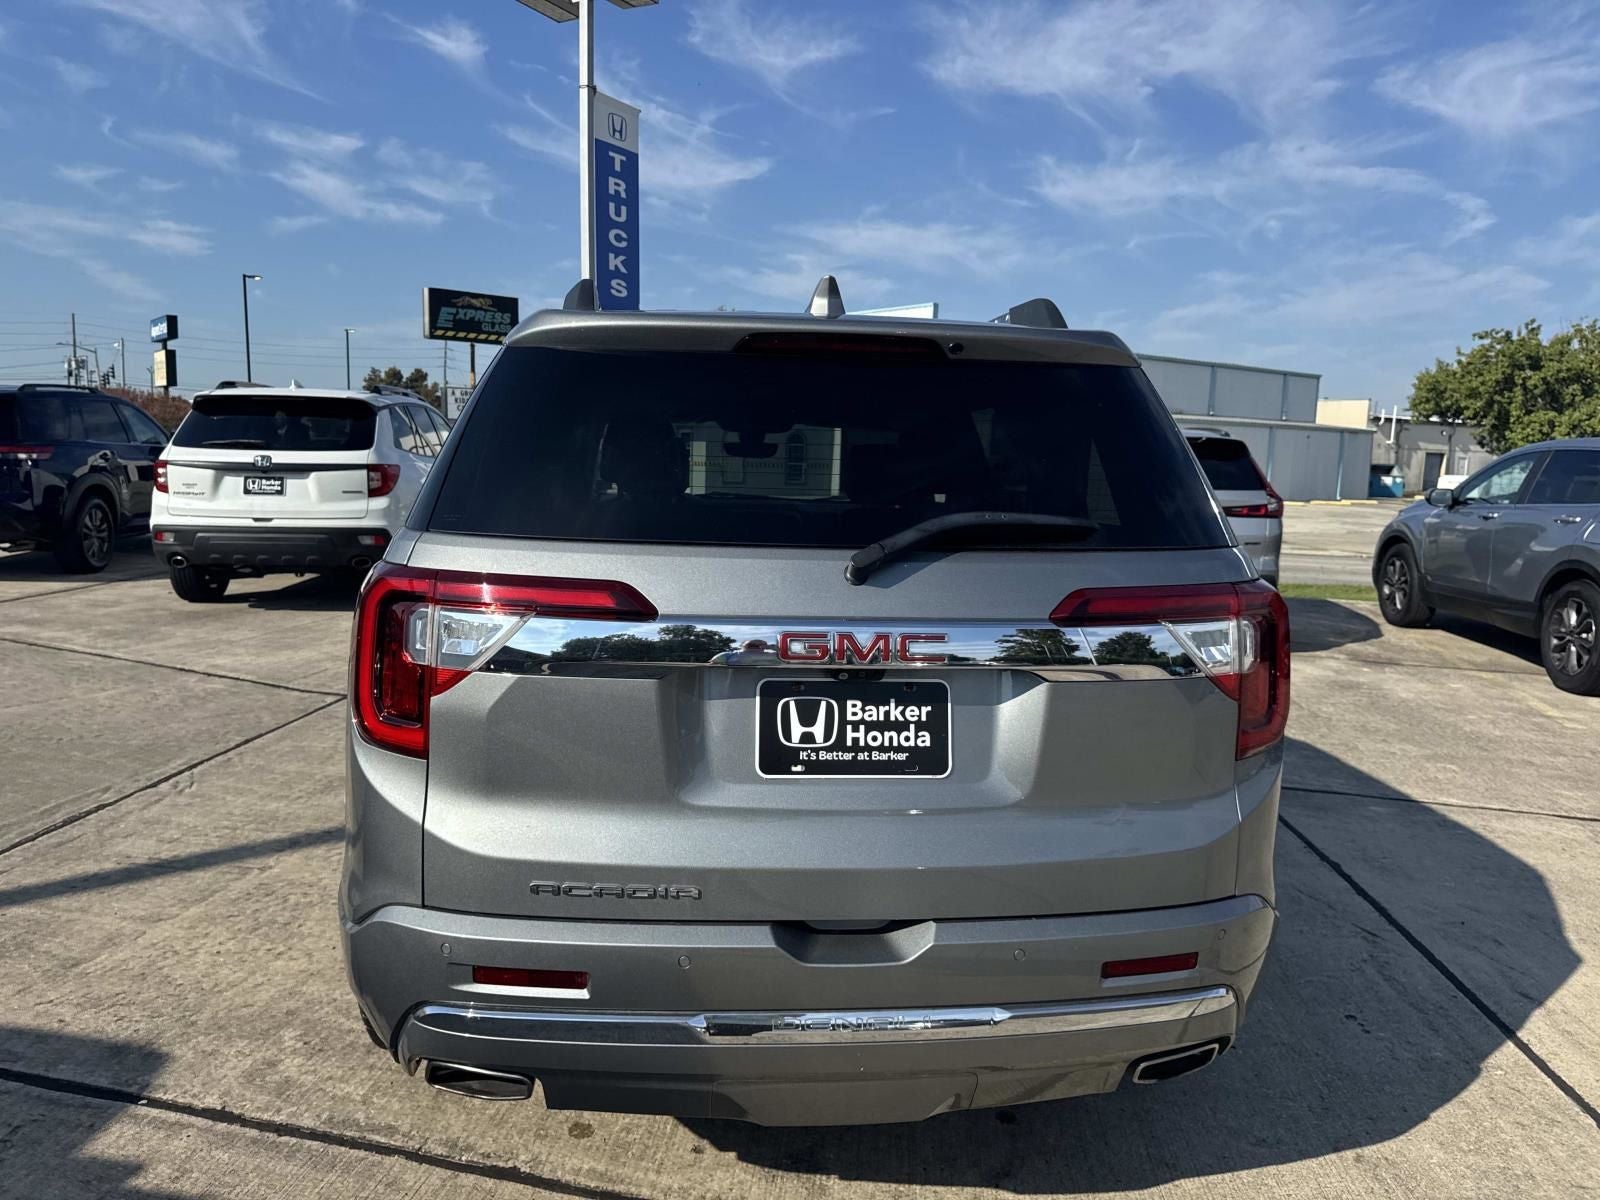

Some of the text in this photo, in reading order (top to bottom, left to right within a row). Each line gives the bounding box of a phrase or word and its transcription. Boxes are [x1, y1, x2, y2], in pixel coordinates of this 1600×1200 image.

[608, 151, 629, 298] TRUCKS
[436, 306, 512, 328] EXPRESS
[481, 322, 511, 333] GLASS
[778, 631, 948, 665] GMC
[846, 698, 932, 721] Barker
[846, 724, 932, 747] Honda
[799, 749, 909, 760] It's Better at Barker
[529, 880, 702, 900] ACADIA
[772, 1015, 931, 1032] DENALI
